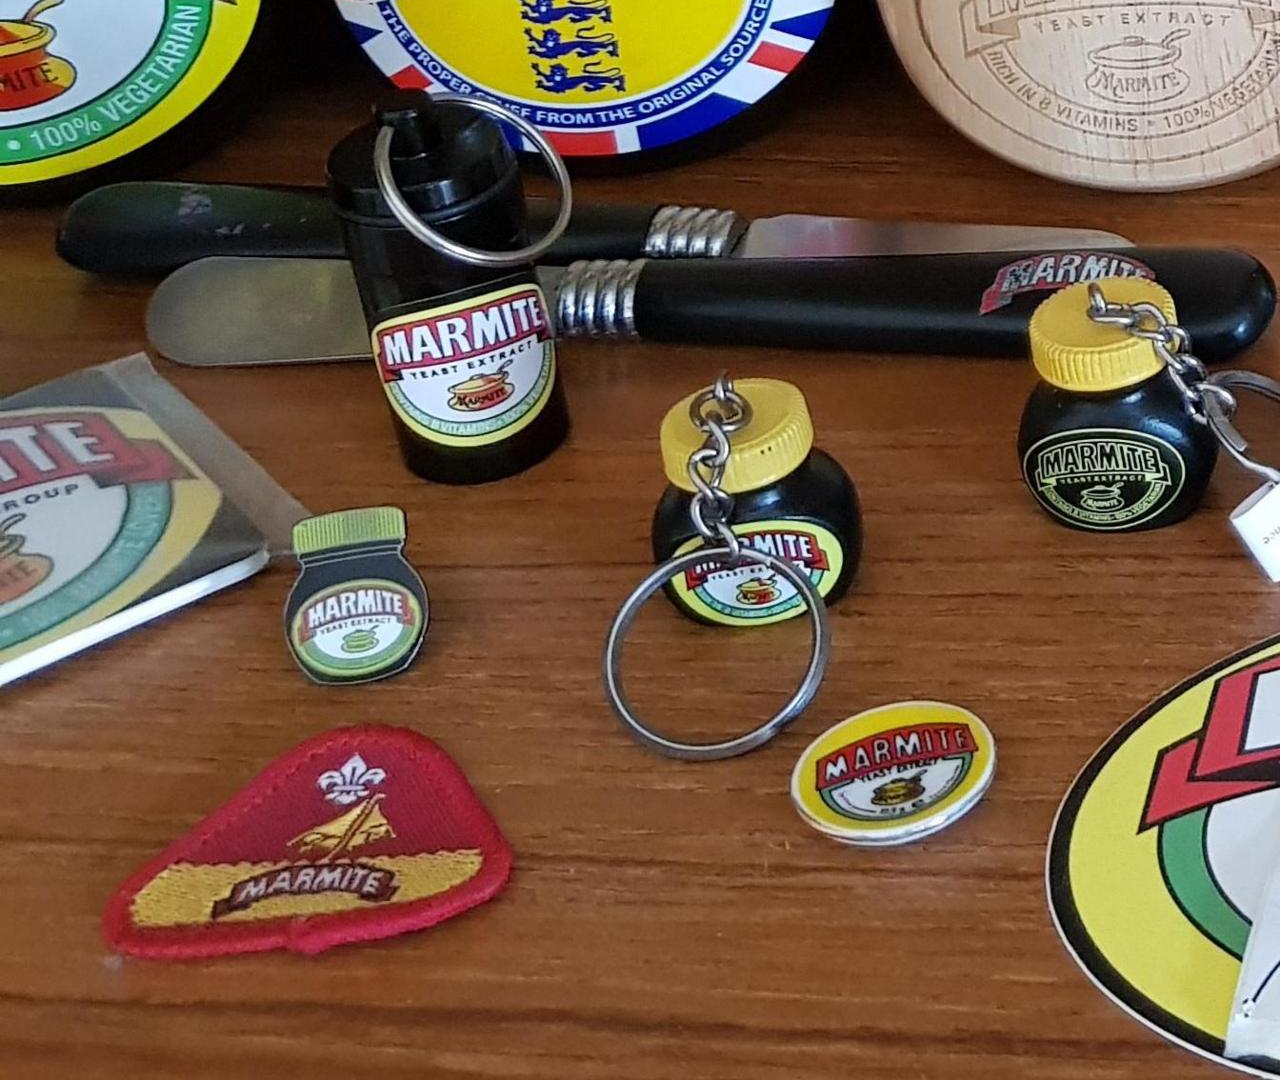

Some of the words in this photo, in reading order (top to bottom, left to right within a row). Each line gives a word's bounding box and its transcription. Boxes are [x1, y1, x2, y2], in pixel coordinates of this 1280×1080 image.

[1033, 12, 1105, 33] YEAST
[1119, 10, 1234, 27] EXTRACT
[30, 116, 101, 151] 100%
[100, 4, 202, 120] VEGETARIAN
[380, 4, 411, 45] THE
[410, 42, 472, 96] PROPER
[536, 109, 596, 125] FROM
[597, 105, 637, 124] THE
[639, 67, 723, 118] ORIGINAL
[1095, 69, 1183, 98] MARMITE
[1054, 101, 1140, 133] VITAMINS
[383, 296, 544, 367] MARMITE
[409, 364, 459, 381] YEAST
[466, 339, 533, 369] EXTRACT
[1044, 442, 1161, 478] MARMITE
[308, 589, 403, 628] MARMITE
[237, 866, 385, 902] MARMITE
